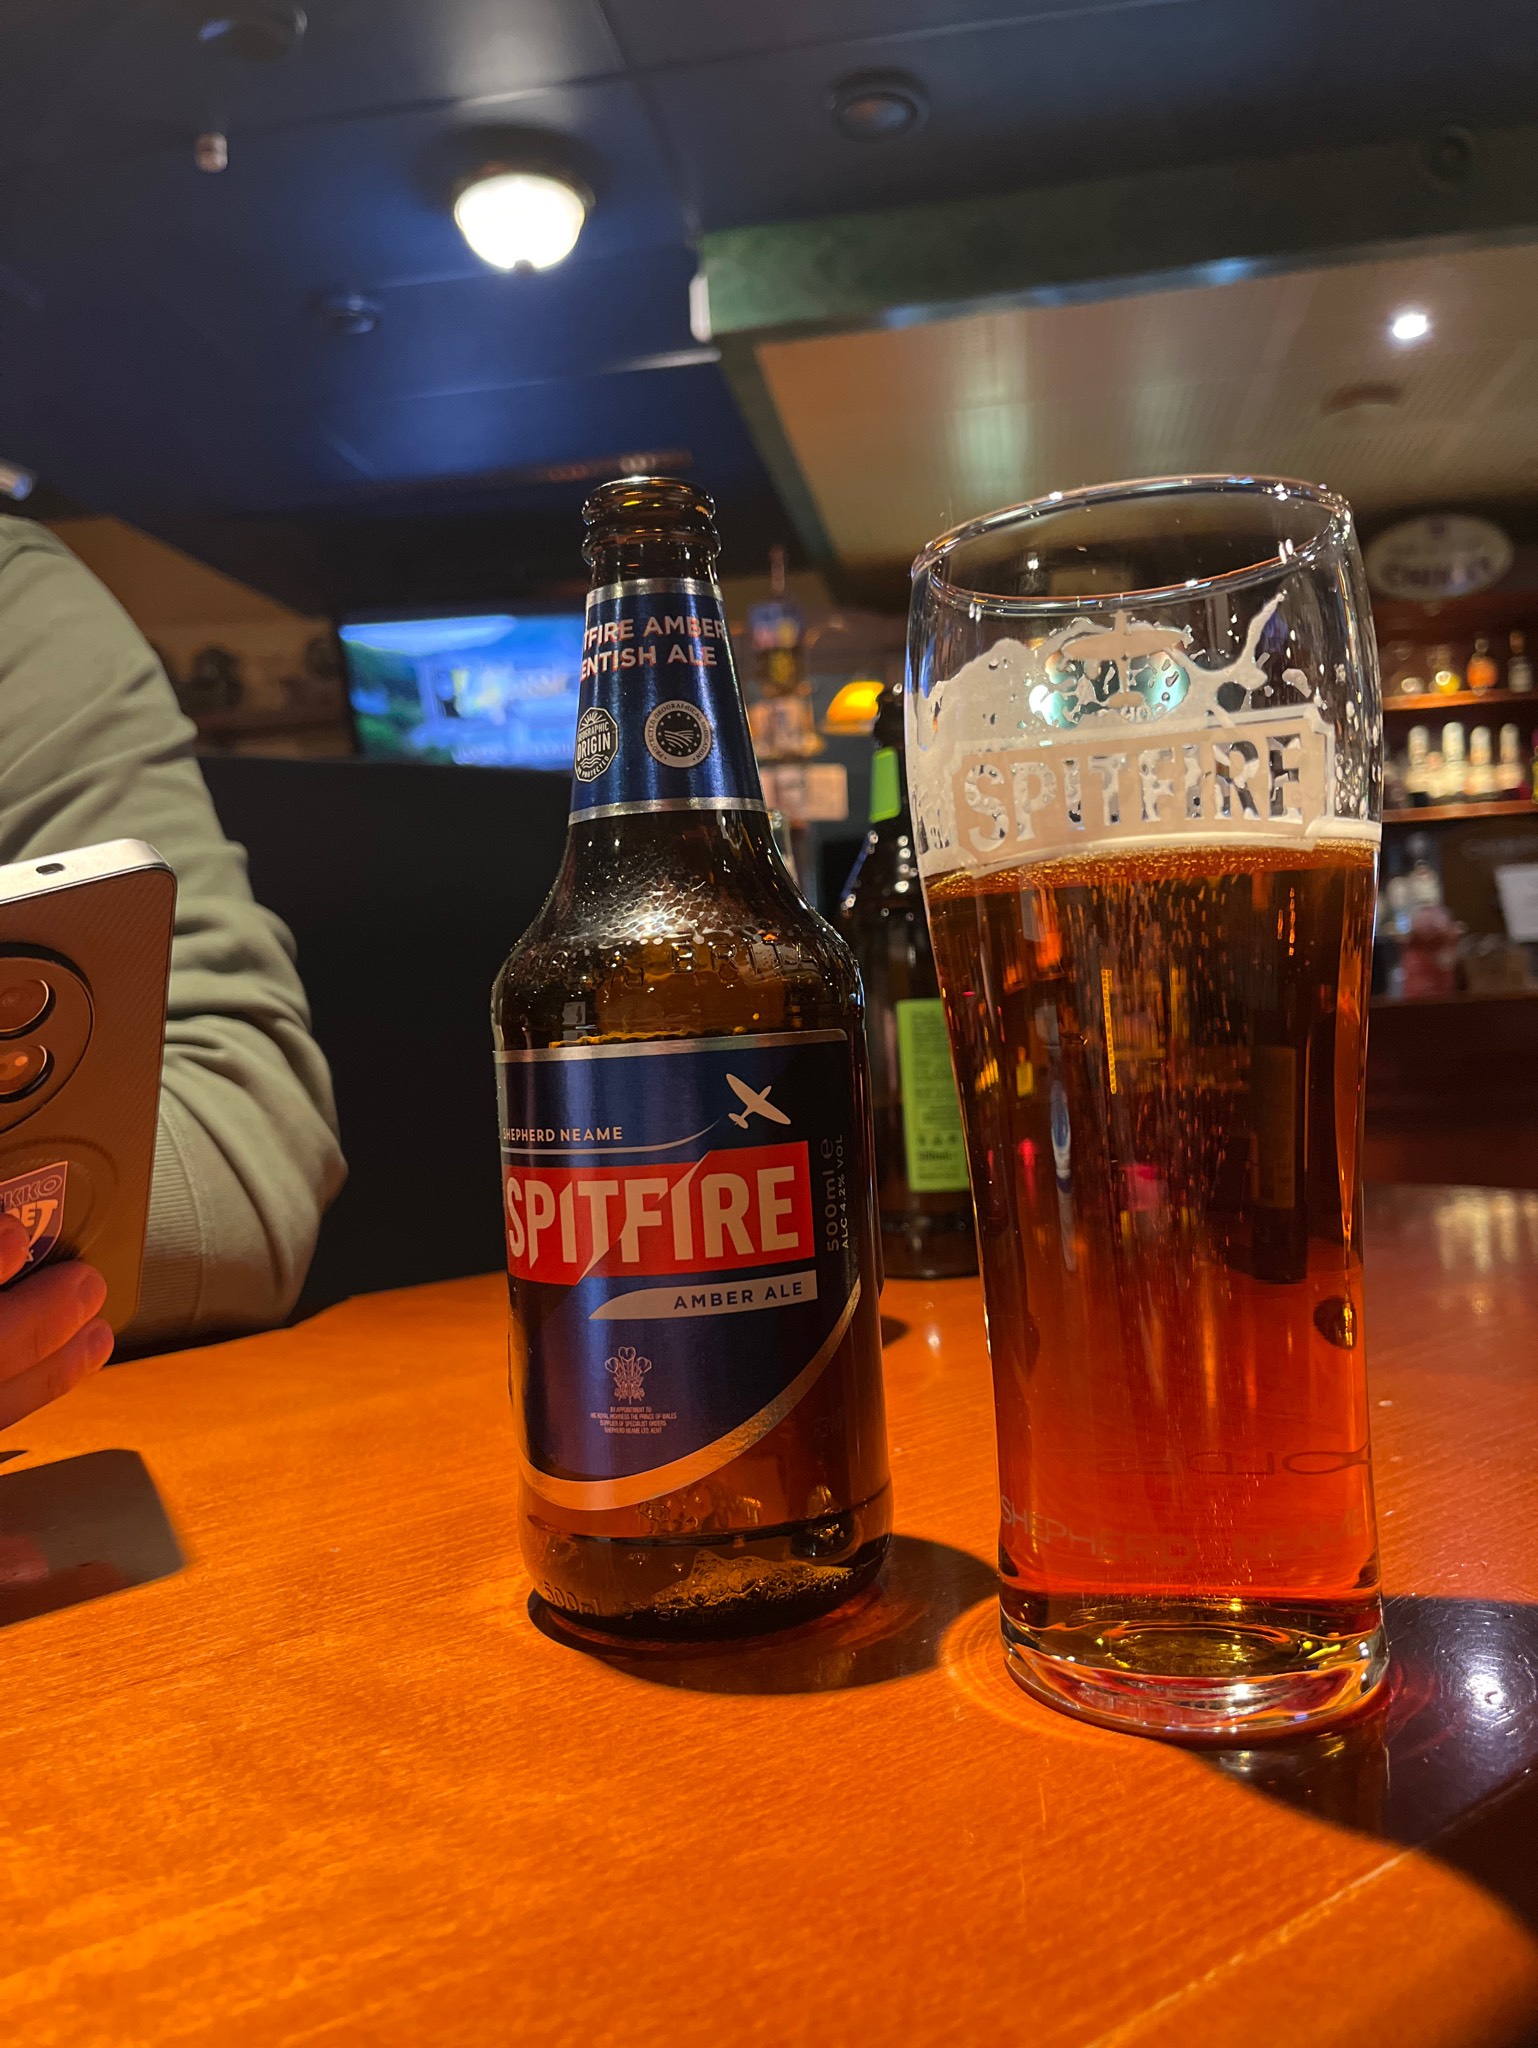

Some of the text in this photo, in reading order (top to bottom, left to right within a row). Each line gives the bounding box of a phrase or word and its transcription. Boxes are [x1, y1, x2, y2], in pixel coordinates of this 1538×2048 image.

[643, 615, 725, 638] AMBER
[667, 644, 717, 666] ALE
[577, 731, 611, 761] ORIGIN
[964, 734, 1303, 852] SPITFIRE
[503, 1126, 623, 1142] SHEPHERD NEAME
[506, 1151, 799, 1285] SPITFIRE
[673, 1281, 803, 1310] AMBER ALE
